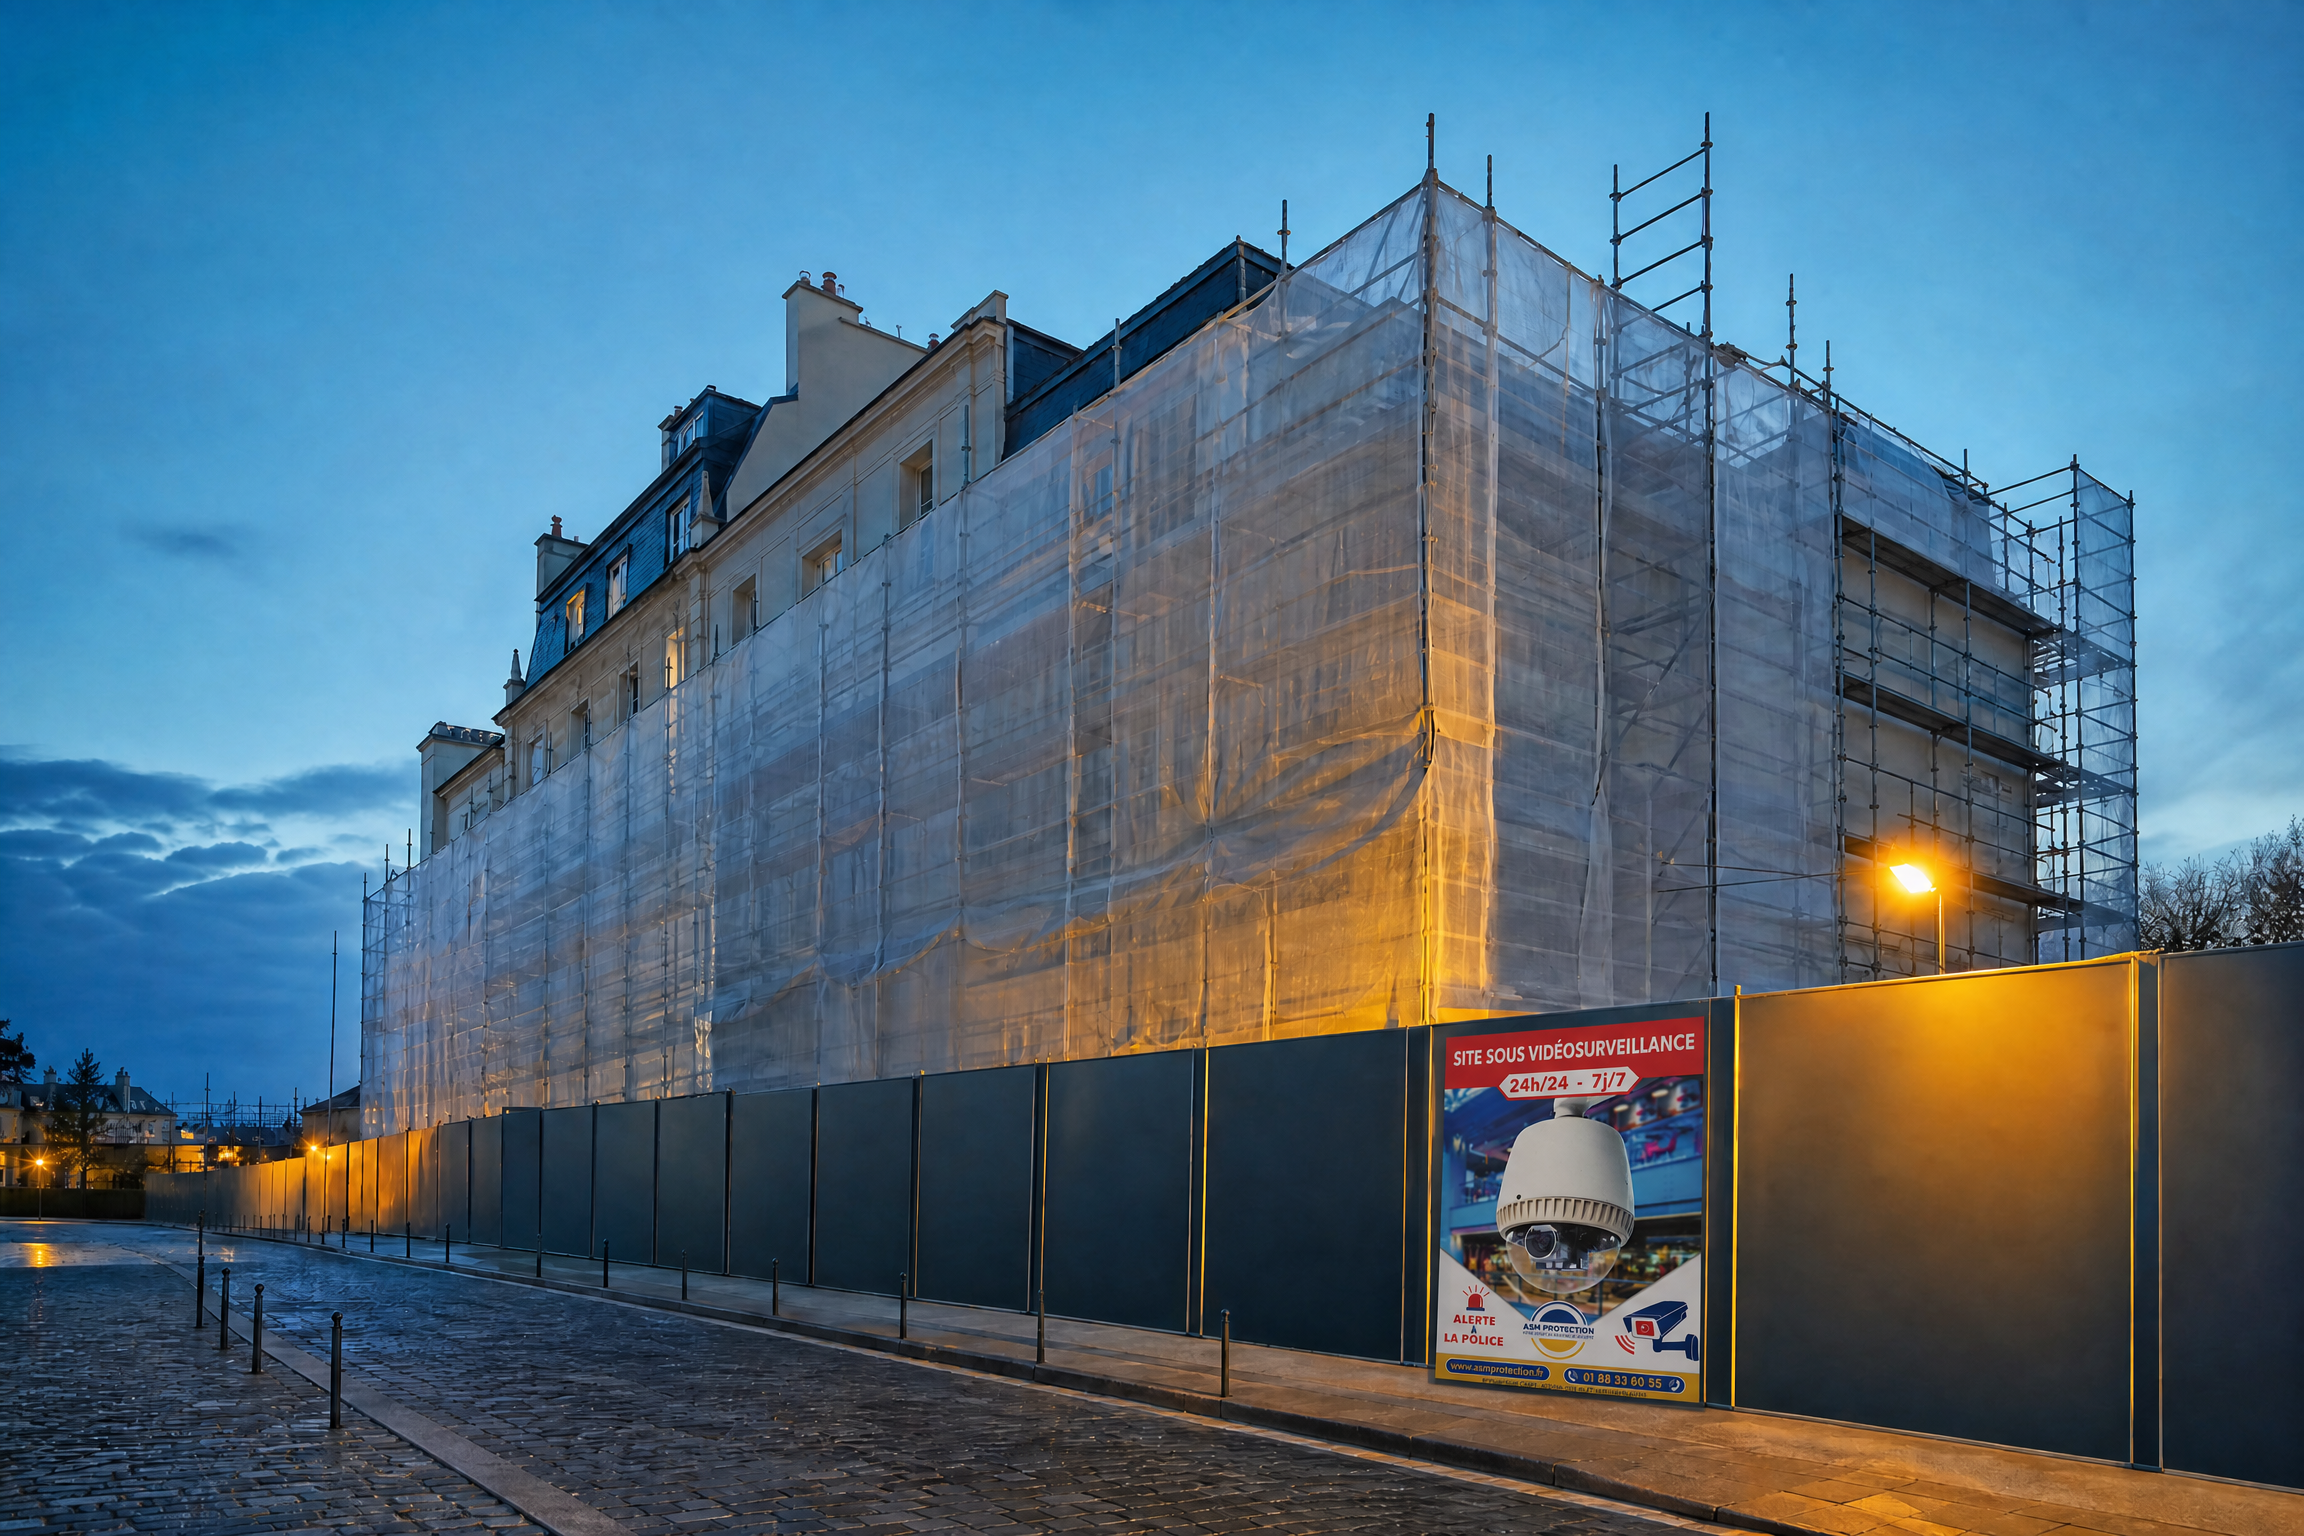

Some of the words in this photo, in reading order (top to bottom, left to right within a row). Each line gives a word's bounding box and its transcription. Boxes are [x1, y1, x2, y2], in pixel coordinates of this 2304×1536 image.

[1454, 1050, 1482, 1066] SITE
[1486, 1046, 1525, 1064] SOUS
[1528, 1033, 1695, 1061] VIDÉOSURVEILLANCE
[1509, 1076, 1568, 1093] 24h/24
[1592, 1072, 1626, 1092] 7j/7
[1453, 1314, 1496, 1326] ALERTE
[1543, 1325, 1594, 1334] PROTECTION
[1444, 1333, 1458, 1343] LA
[1462, 1334, 1504, 1346] POLICE
[1450, 1362, 1544, 1377] www.asmprotection.fr
[1583, 1372, 1594, 1382] 01
[1614, 1376, 1628, 1386] 33
[1648, 1378, 1662, 1388] 55
